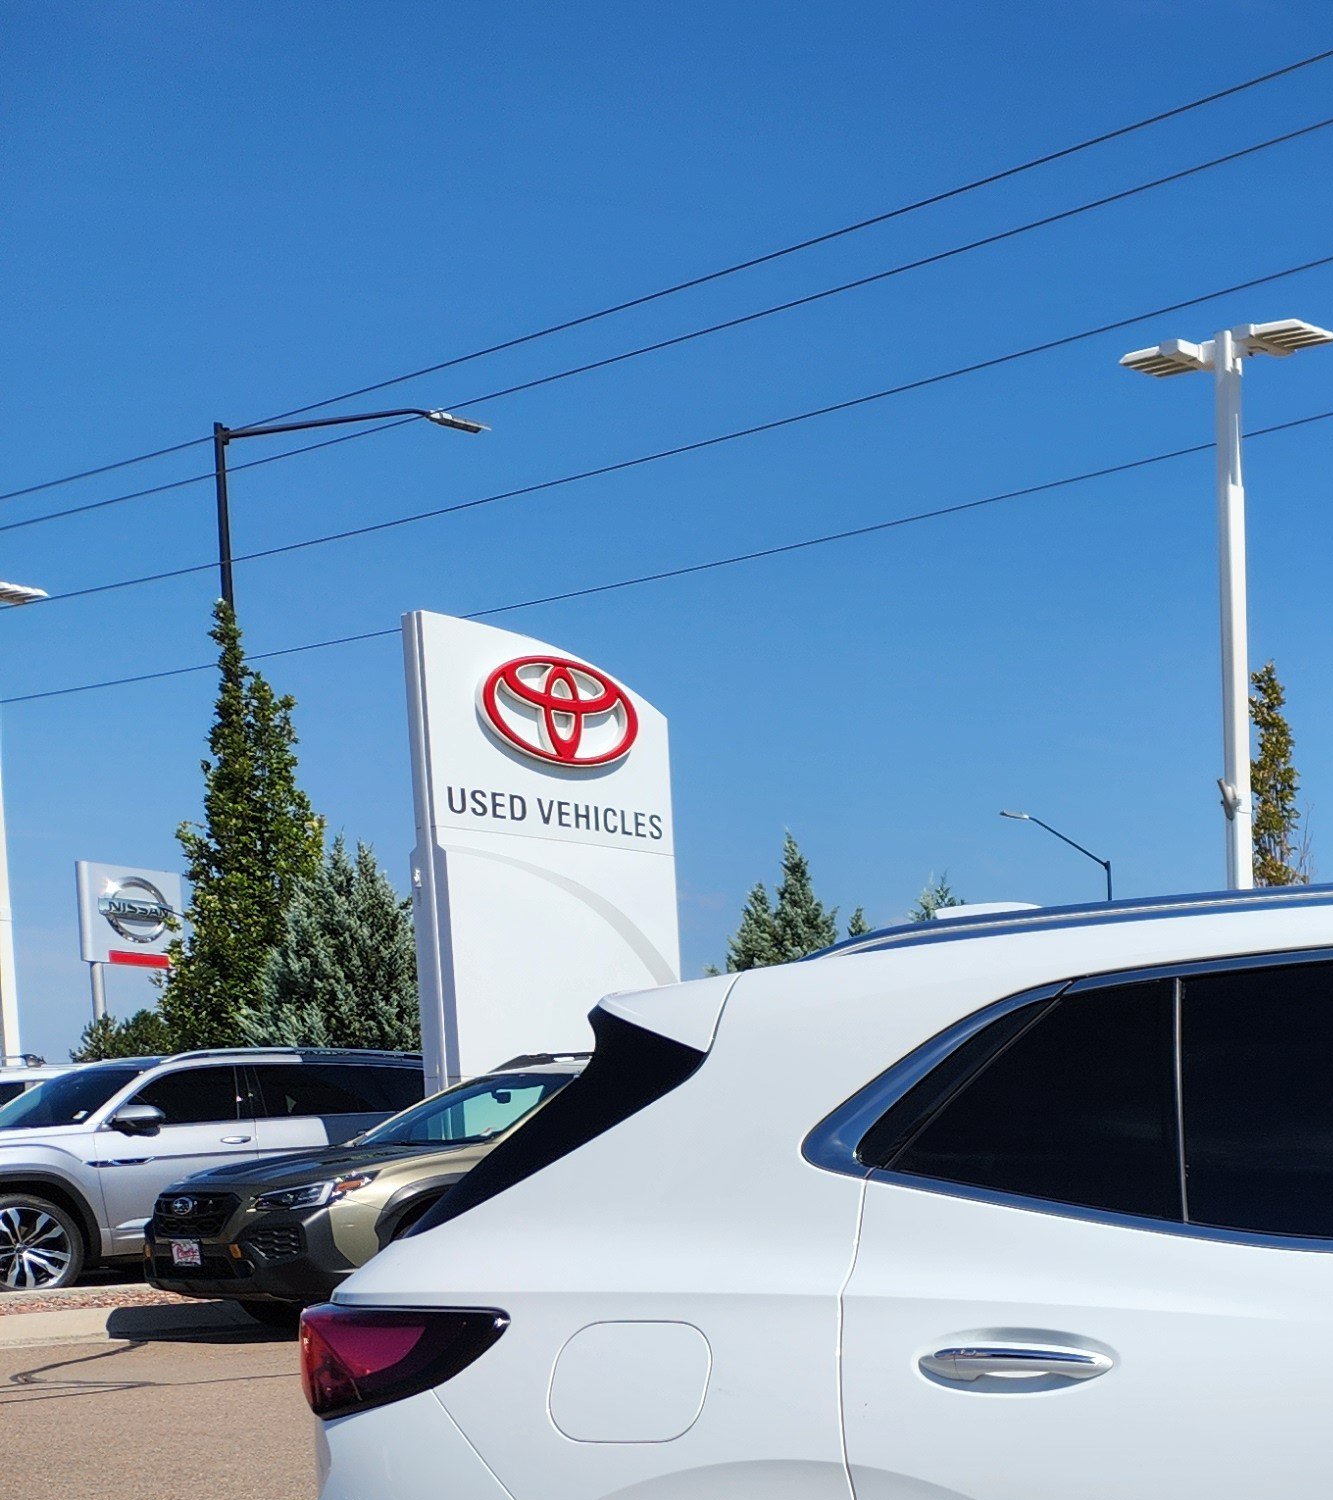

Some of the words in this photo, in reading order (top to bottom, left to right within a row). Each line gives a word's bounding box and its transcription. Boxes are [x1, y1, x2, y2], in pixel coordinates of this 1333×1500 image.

[447, 786, 527, 821] USED
[536, 798, 663, 840] VEHICLES
[108, 901, 168, 918] NISSAN
